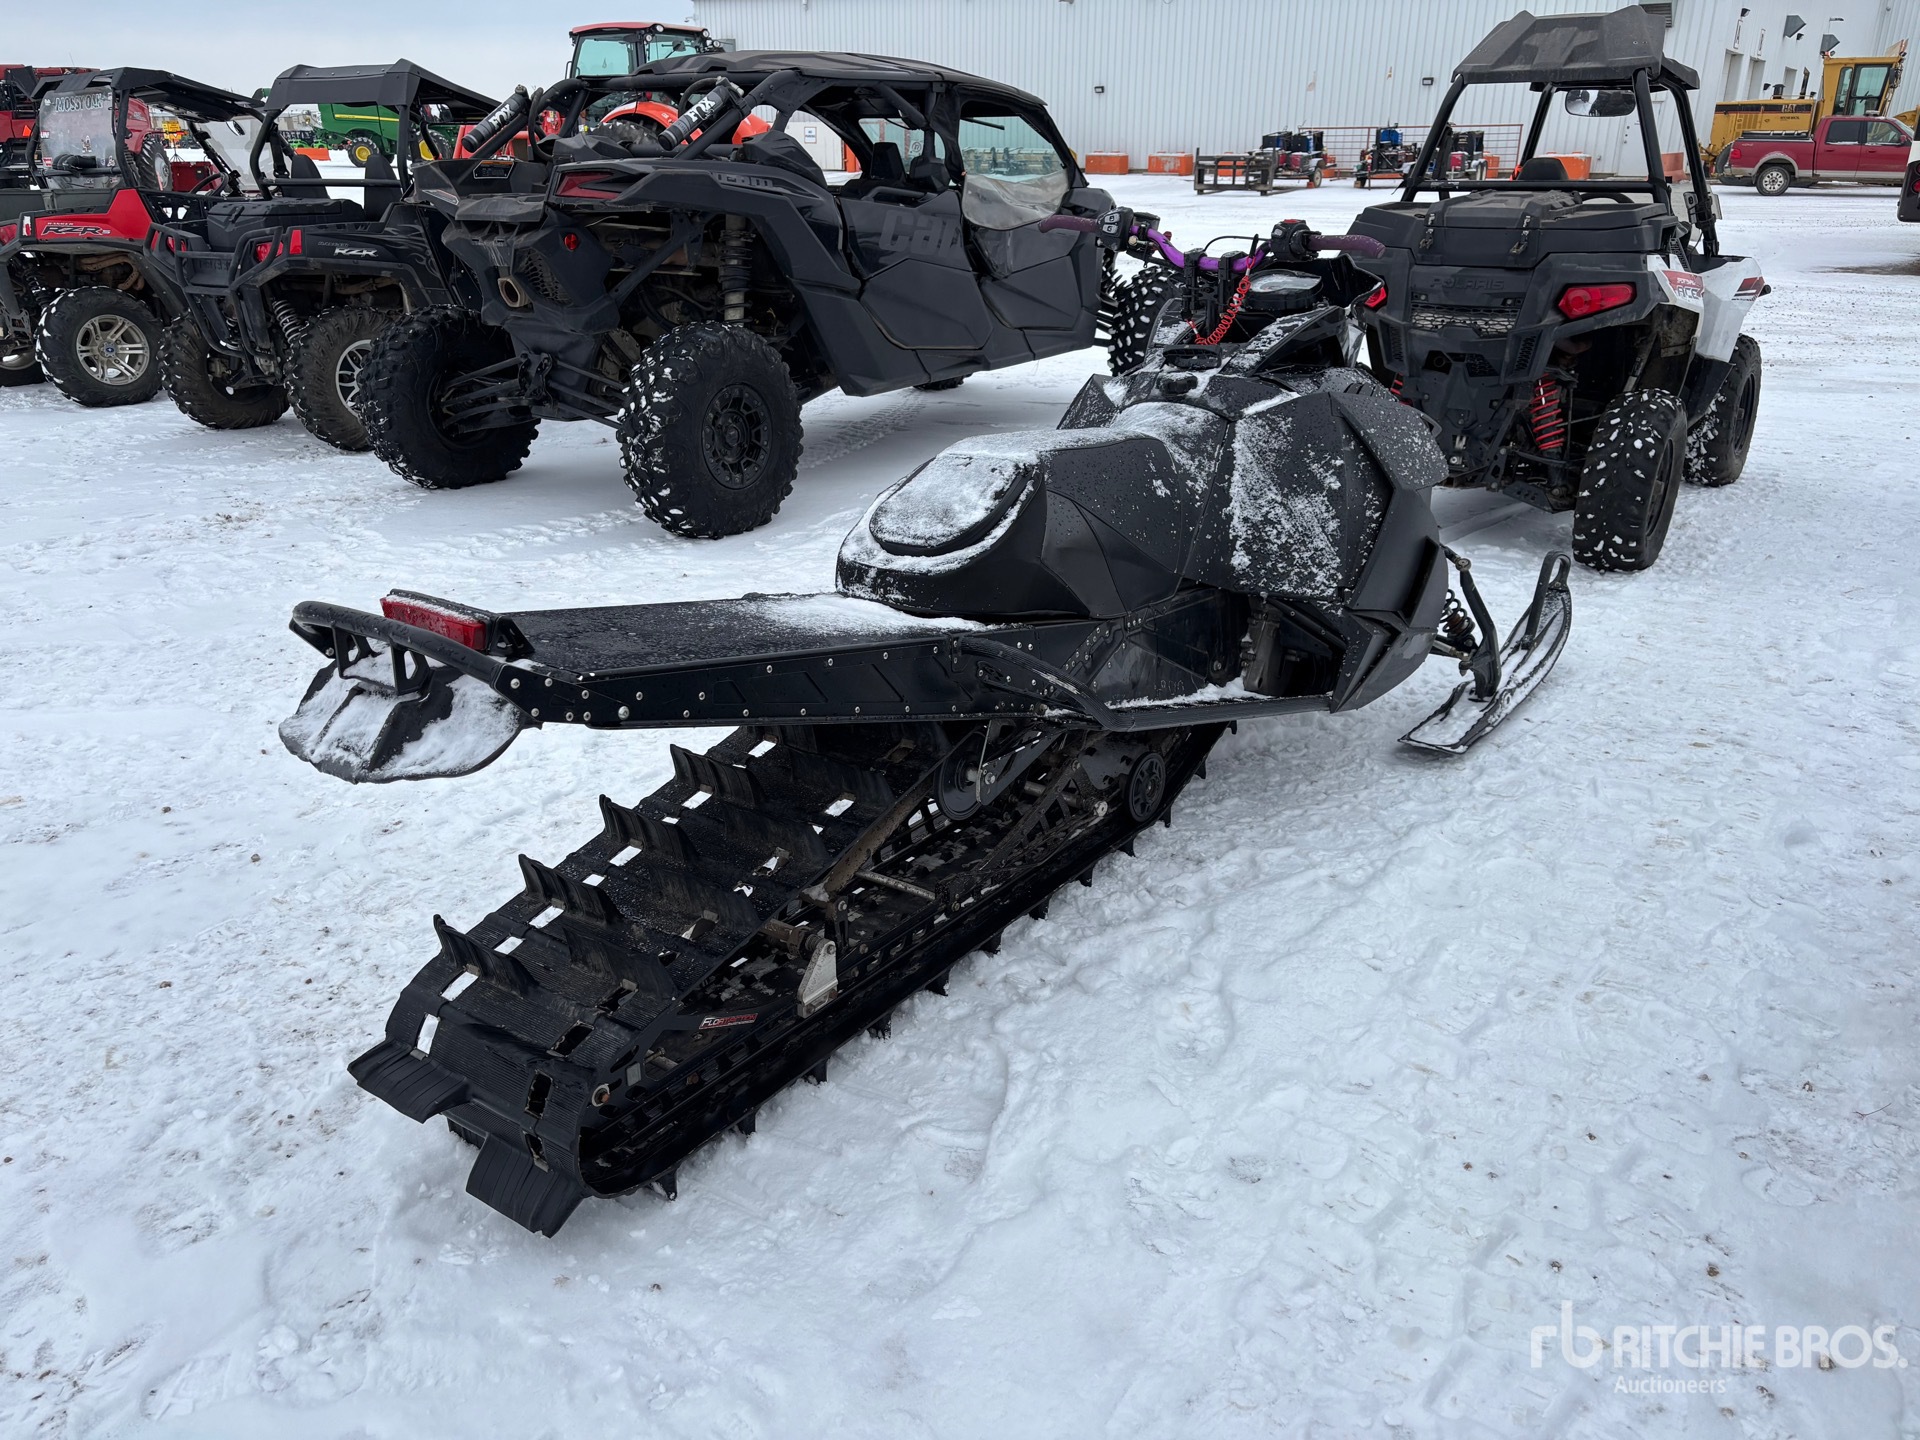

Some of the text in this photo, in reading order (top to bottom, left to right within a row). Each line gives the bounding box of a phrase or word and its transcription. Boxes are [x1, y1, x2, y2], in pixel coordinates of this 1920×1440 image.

[684, 96, 716, 122] FOX
[488, 103, 516, 131] FOX
[41, 225, 103, 236] RZR
[334, 247, 379, 257] RZR
[1430, 276, 1505, 291] POLARIS
[1677, 286, 1700, 299] ACE
